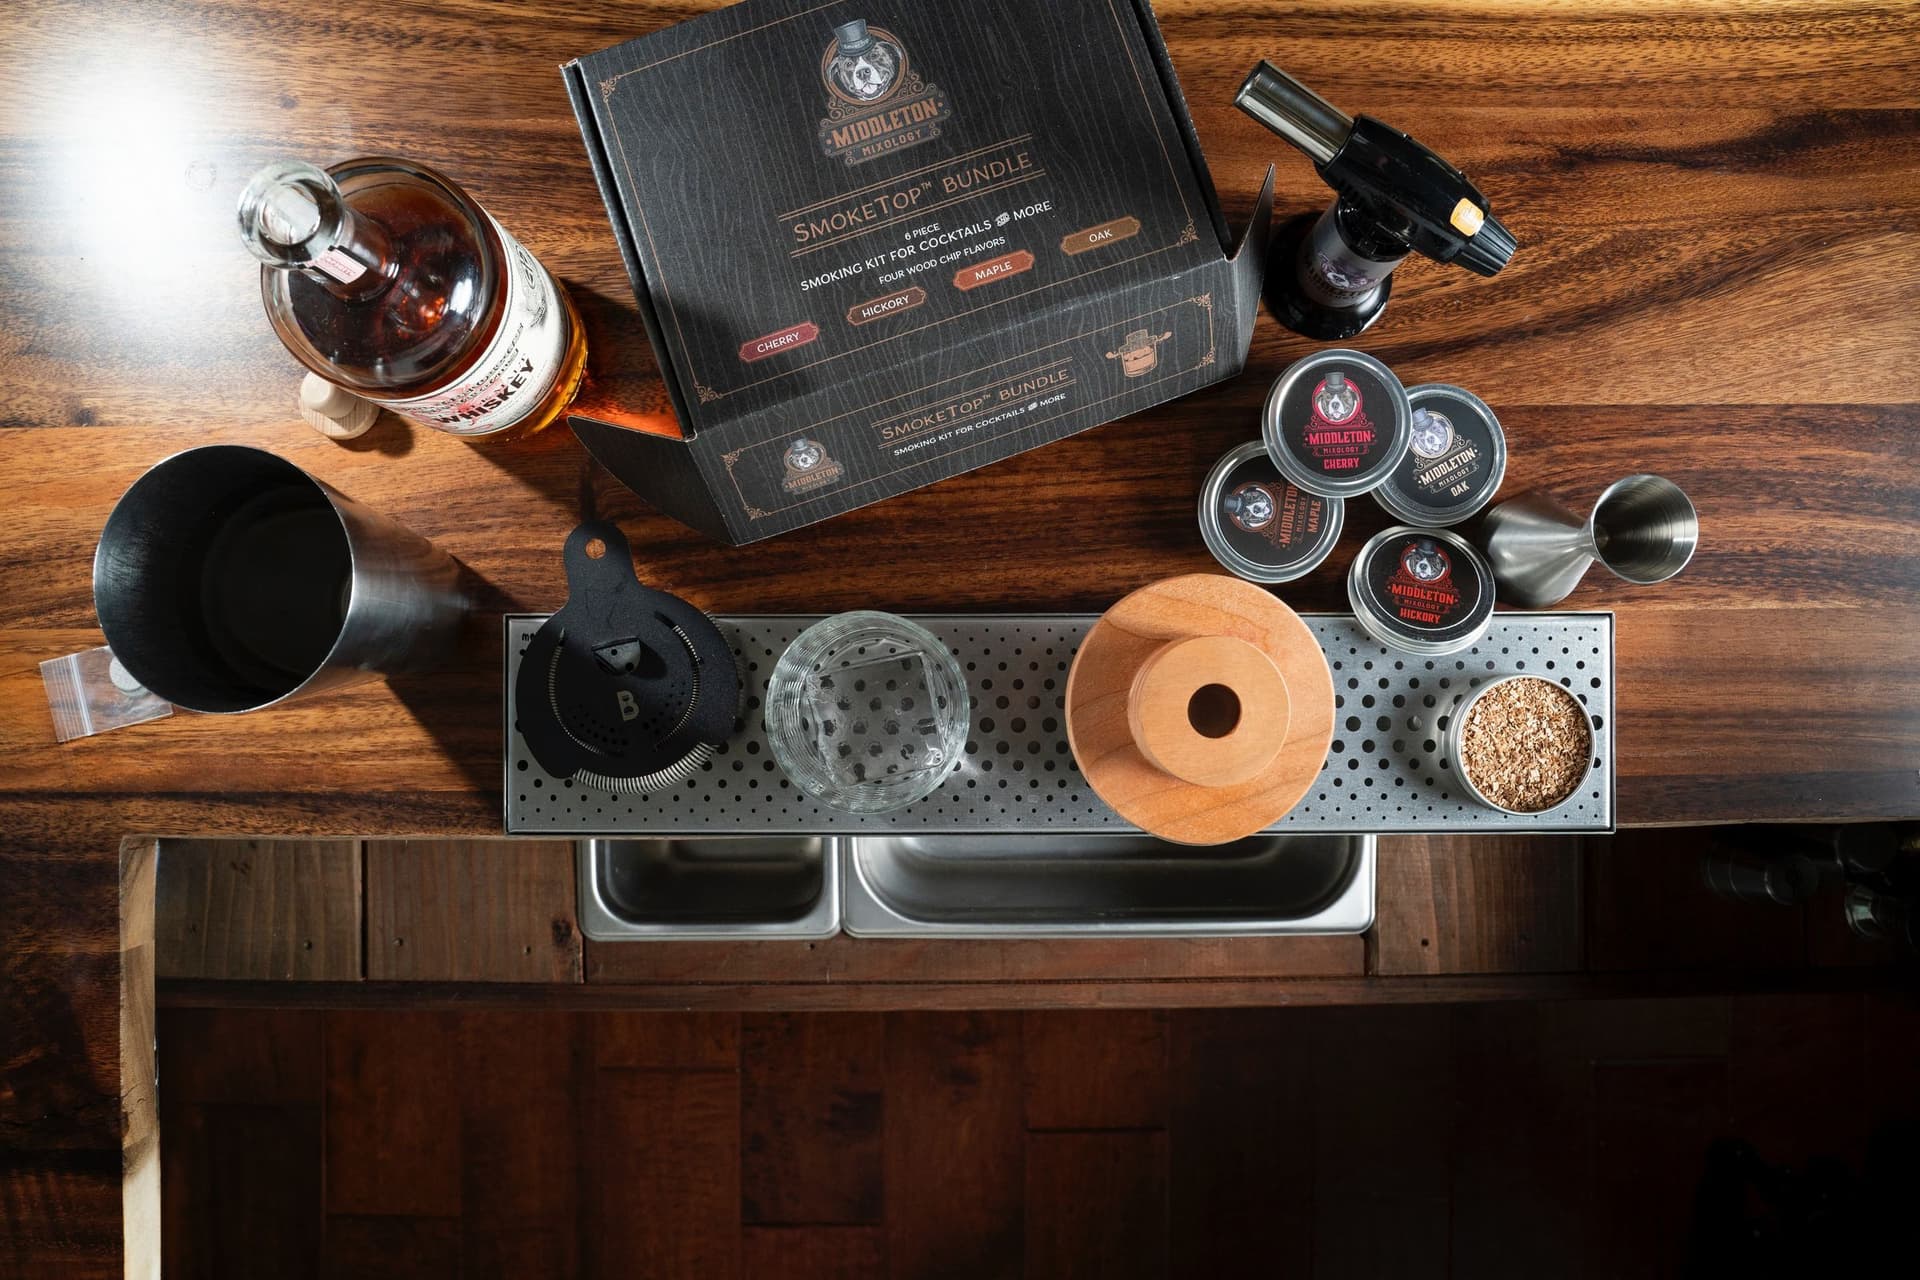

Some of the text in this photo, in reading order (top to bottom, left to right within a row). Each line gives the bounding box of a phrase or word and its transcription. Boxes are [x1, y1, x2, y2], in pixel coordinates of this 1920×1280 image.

[831, 98, 938, 149] MIDDLETON
[862, 130, 922, 156] MIXOLOGY
[942, 152, 1033, 193] BUNDLE
[904, 223, 940, 241] 6 PIECE
[1089, 229, 1113, 243] OAK
[800, 262, 863, 291] SMOKING
[865, 254, 886, 270] KIT
[890, 244, 916, 263] FOR
[919, 219, 992, 258] COCKTAILS
[1013, 200, 1052, 220] MORE
[879, 236, 1006, 285] FOUR WOOD CHIP FLAVORS
[975, 261, 1013, 280] MAPLE
[861, 295, 910, 318] HICKORY
[756, 332, 800, 354] CHERRY
[434, 358, 534, 424] WHISKEY
[999, 369, 1070, 401] BUNDLE
[893, 437, 937, 457] SMOKING
[938, 431, 953, 443] KIT
[955, 425, 973, 436] FOR
[975, 407, 1026, 429] COCKTAILS
[1040, 393, 1067, 407] MORE
[1308, 430, 1372, 445] MIDDLETON
[1323, 447, 1360, 455] MIXOLOGY
[1323, 458, 1359, 470] CHERRY
[1420, 448, 1477, 486] MIDDLETON
[788, 466, 839, 489] MIDDLETON
[1438, 468, 1470, 487] MIXOLOGY
[1450, 483, 1470, 497] OAK
[1307, 500, 1321, 533] MAPLE
[1391, 583, 1454, 605] MIDDLETON
[1404, 599, 1441, 611] MIXOLOGY
[1400, 608, 1441, 624] HICKORY
[617, 690, 639, 721] B
